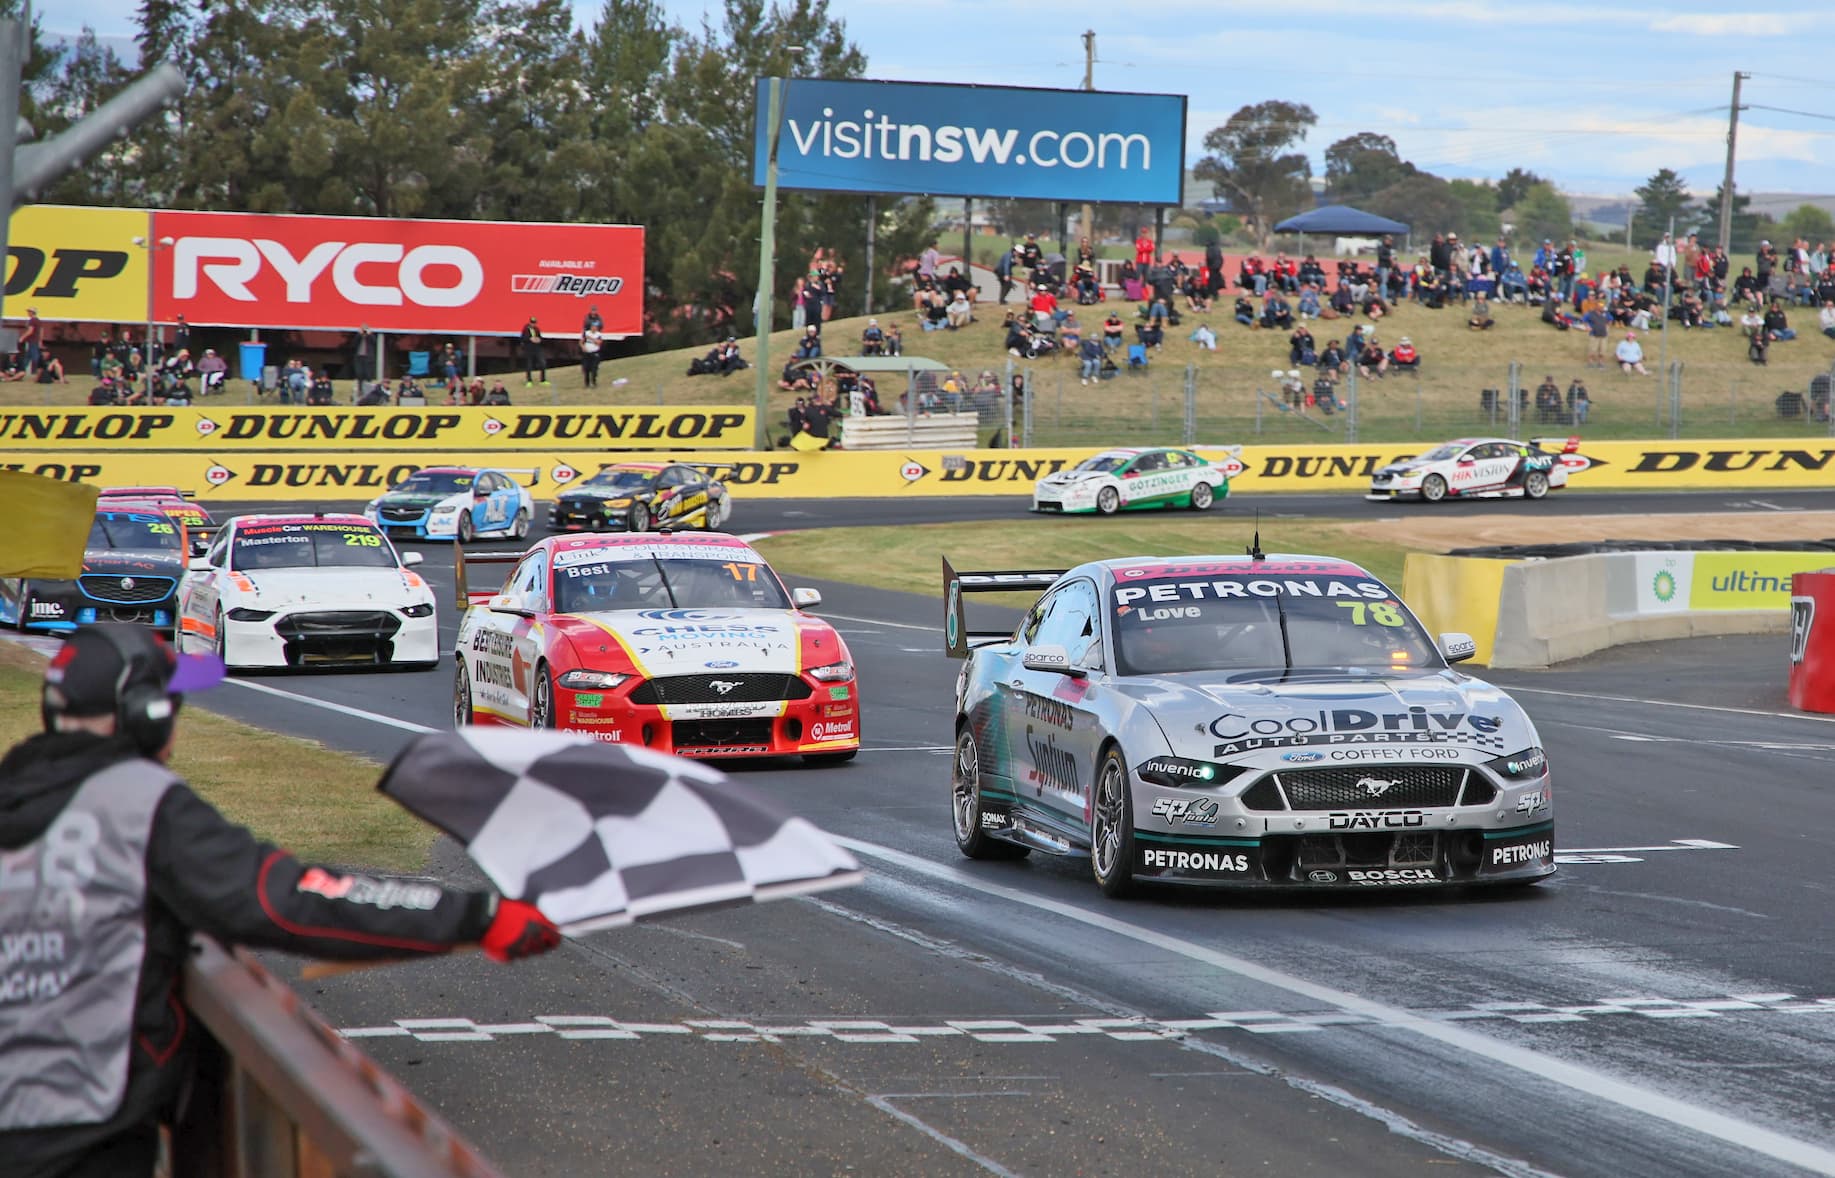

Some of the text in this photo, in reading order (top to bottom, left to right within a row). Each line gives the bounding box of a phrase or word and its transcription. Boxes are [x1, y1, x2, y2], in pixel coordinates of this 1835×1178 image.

[788, 107, 1151, 170] visitnsw.com
[173, 236, 484, 308] RYCO
[555, 274, 622, 296] Repco
[221, 414, 461, 440] DUNLOP
[509, 413, 745, 439] DUNLOP
[146, 522, 175, 534] 26
[241, 535, 310, 547] Masterton
[343, 533, 382, 548] 219
[1665, 557, 1677, 568] bp
[567, 563, 611, 579] Best
[721, 562, 758, 582] 17
[1115, 580, 1389, 606] PETRONAS
[1137, 605, 1202, 622] Love
[1336, 601, 1405, 628] 78
[632, 624, 779, 636] CHESS
[658, 631, 767, 642] MOVING
[658, 640, 789, 652] AUSTRALIA
[1448, 637, 1478, 652] sparc
[1024, 653, 1065, 664] sparco
[1025, 695, 1074, 732] PETRONAS
[1222, 733, 1432, 755] AUTO PARTS
[1288, 751, 1317, 762] Ford
[1331, 748, 1460, 761] COFFEY FORD
[1328, 810, 1424, 830] DAYCO
[1143, 849, 1249, 872] PETRONAS
[1493, 840, 1551, 866] PETRONAS
[1347, 868, 1436, 881] BOSCH
